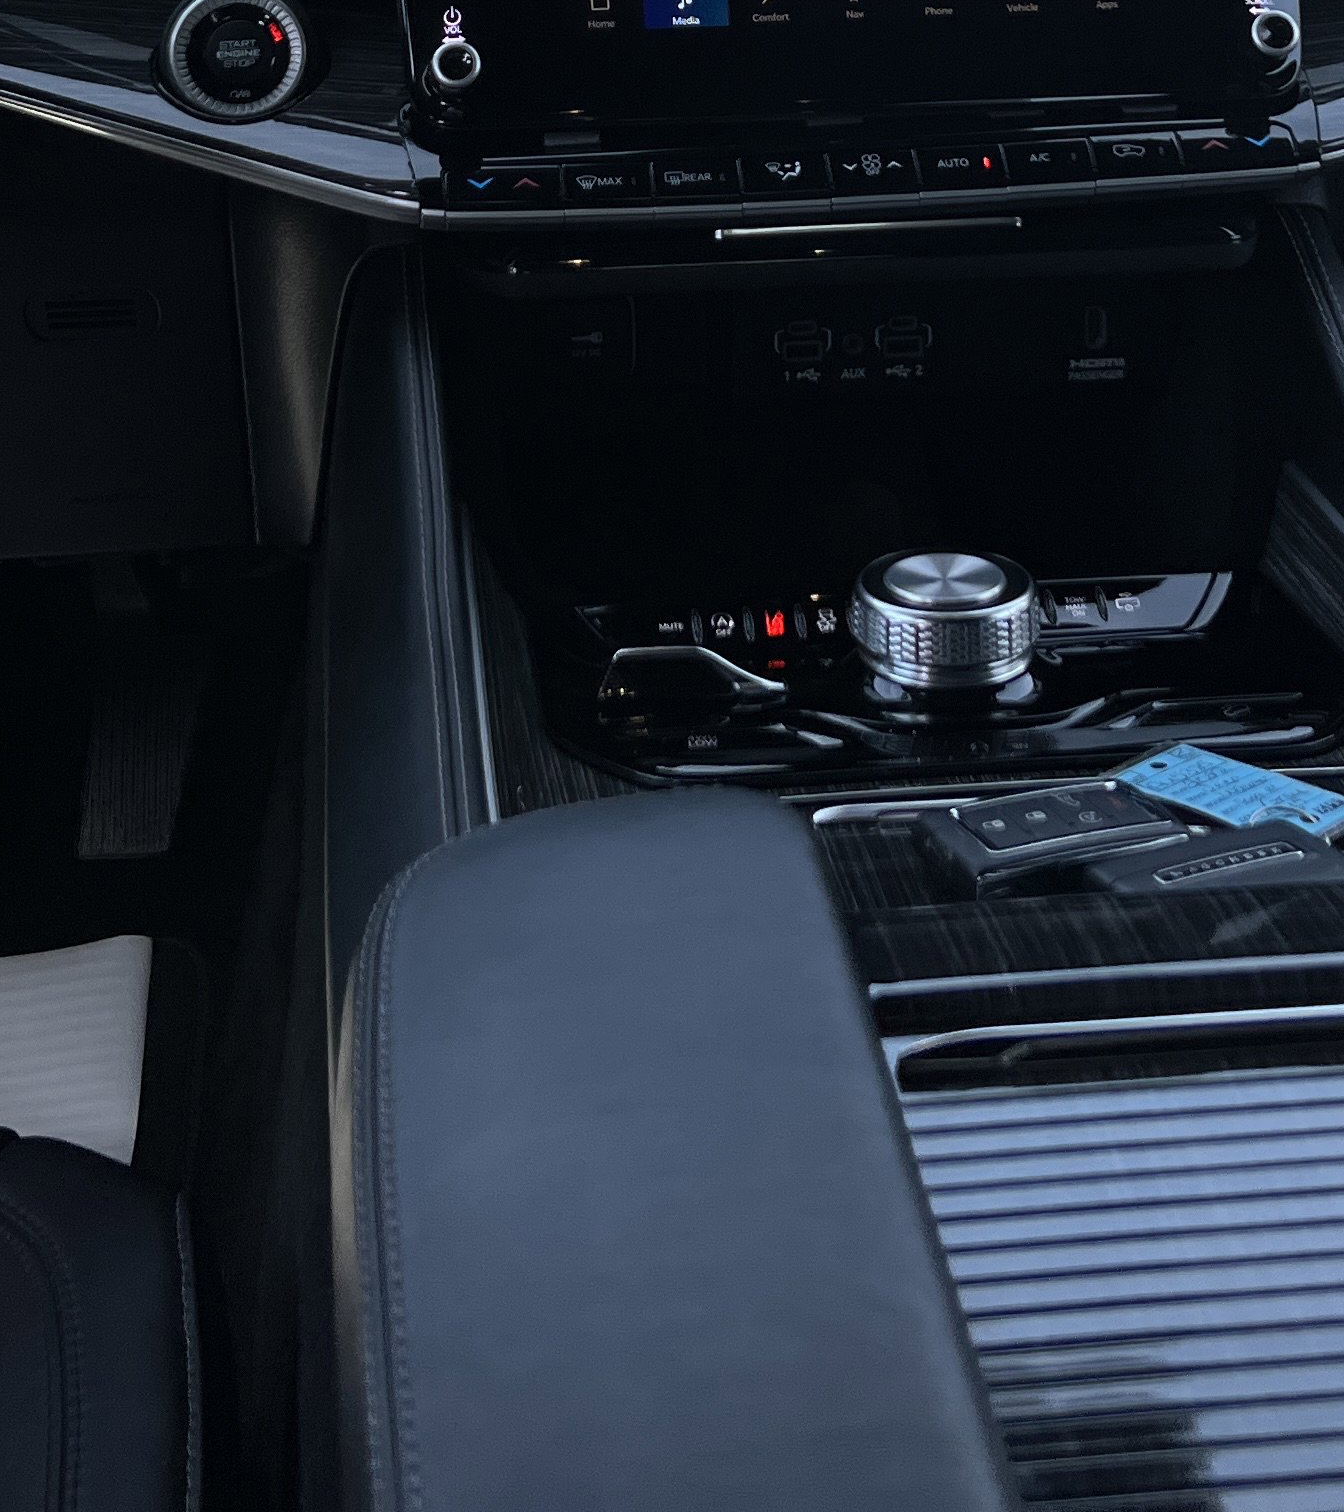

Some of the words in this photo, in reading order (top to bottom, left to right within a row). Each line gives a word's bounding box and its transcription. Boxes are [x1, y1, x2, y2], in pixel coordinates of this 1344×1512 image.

[1006, 3, 1039, 13] Vehicle
[1096, 0, 1119, 10] Apps
[925, 6, 953, 16] Phone
[672, 16, 700, 25] Media
[752, 13, 789, 23] Comfort
[588, 19, 616, 28] Home
[443, 25, 462, 35] VOL
[219, 39, 256, 50] START
[216, 48, 261, 59] ENGINE
[223, 59, 255, 68] STOP
[1029, 152, 1051, 163] A/C
[937, 157, 969, 169] AUTO
[597, 175, 623, 186] MAX
[683, 172, 713, 183] REAR
[840, 367, 867, 379] AUX
